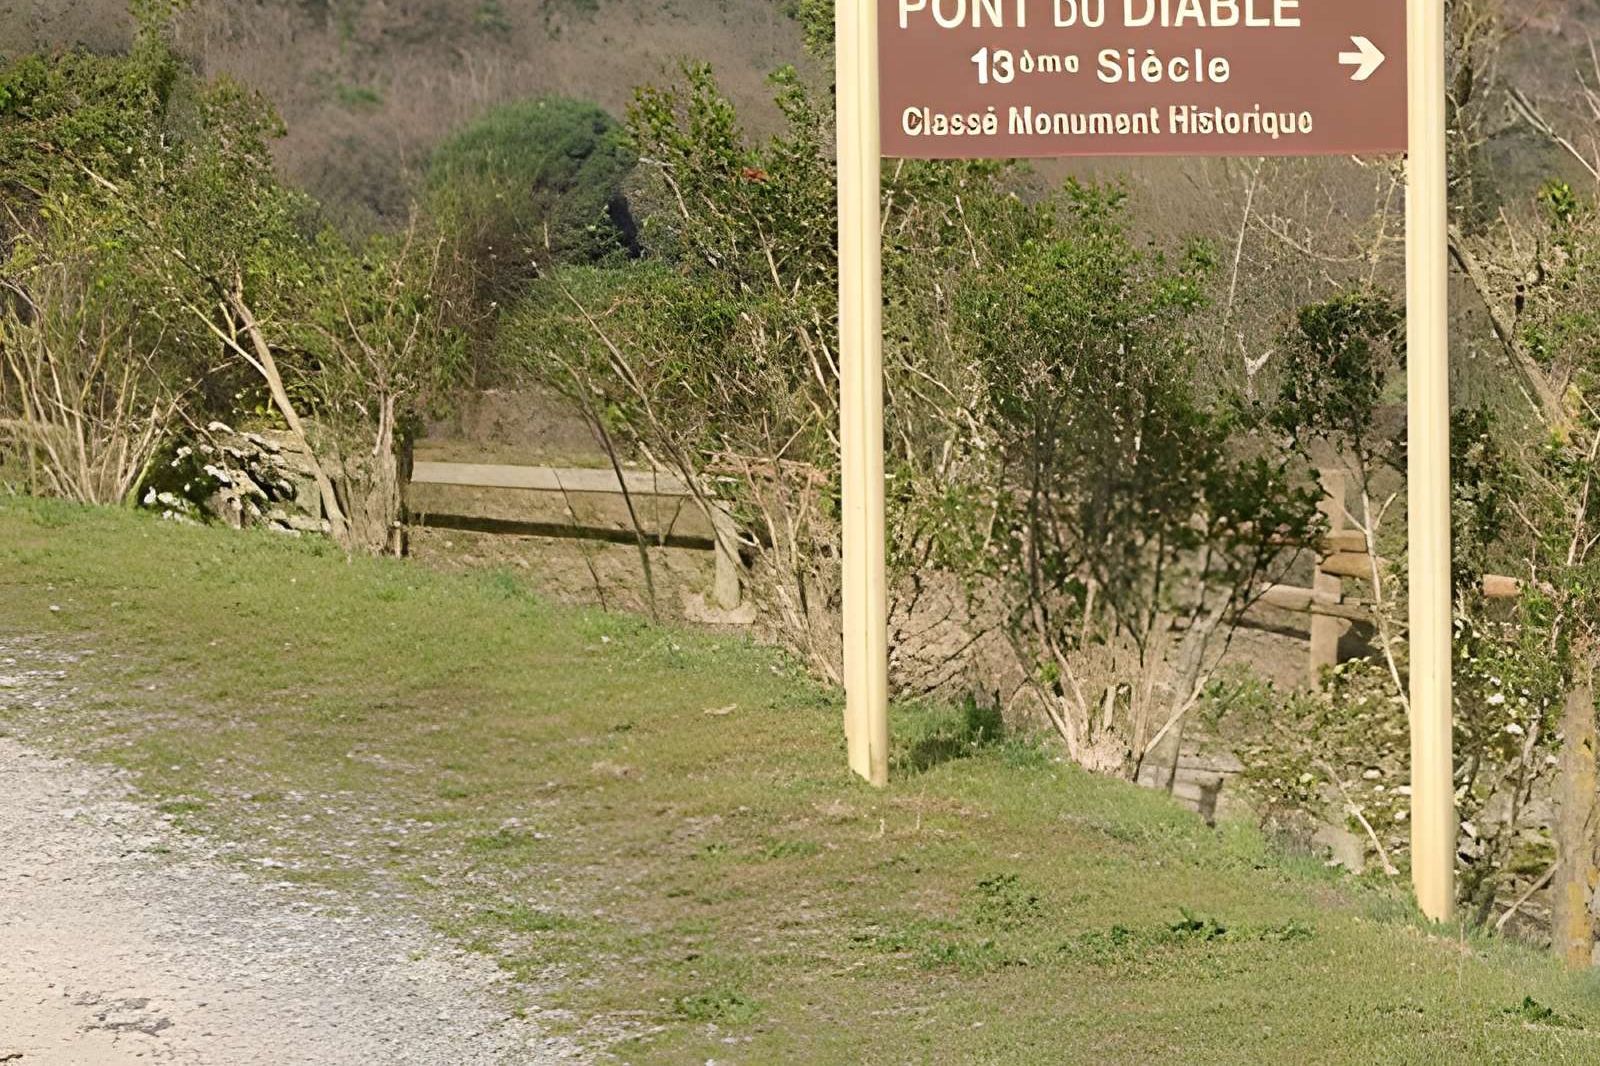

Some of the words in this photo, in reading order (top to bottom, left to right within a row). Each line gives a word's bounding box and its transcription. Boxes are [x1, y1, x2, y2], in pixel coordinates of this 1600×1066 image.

[1096, 47, 1230, 84] Siècle
[901, 105, 998, 137] Classé
[1008, 105, 1161, 136] Monument
[1168, 103, 1313, 140] Historique
